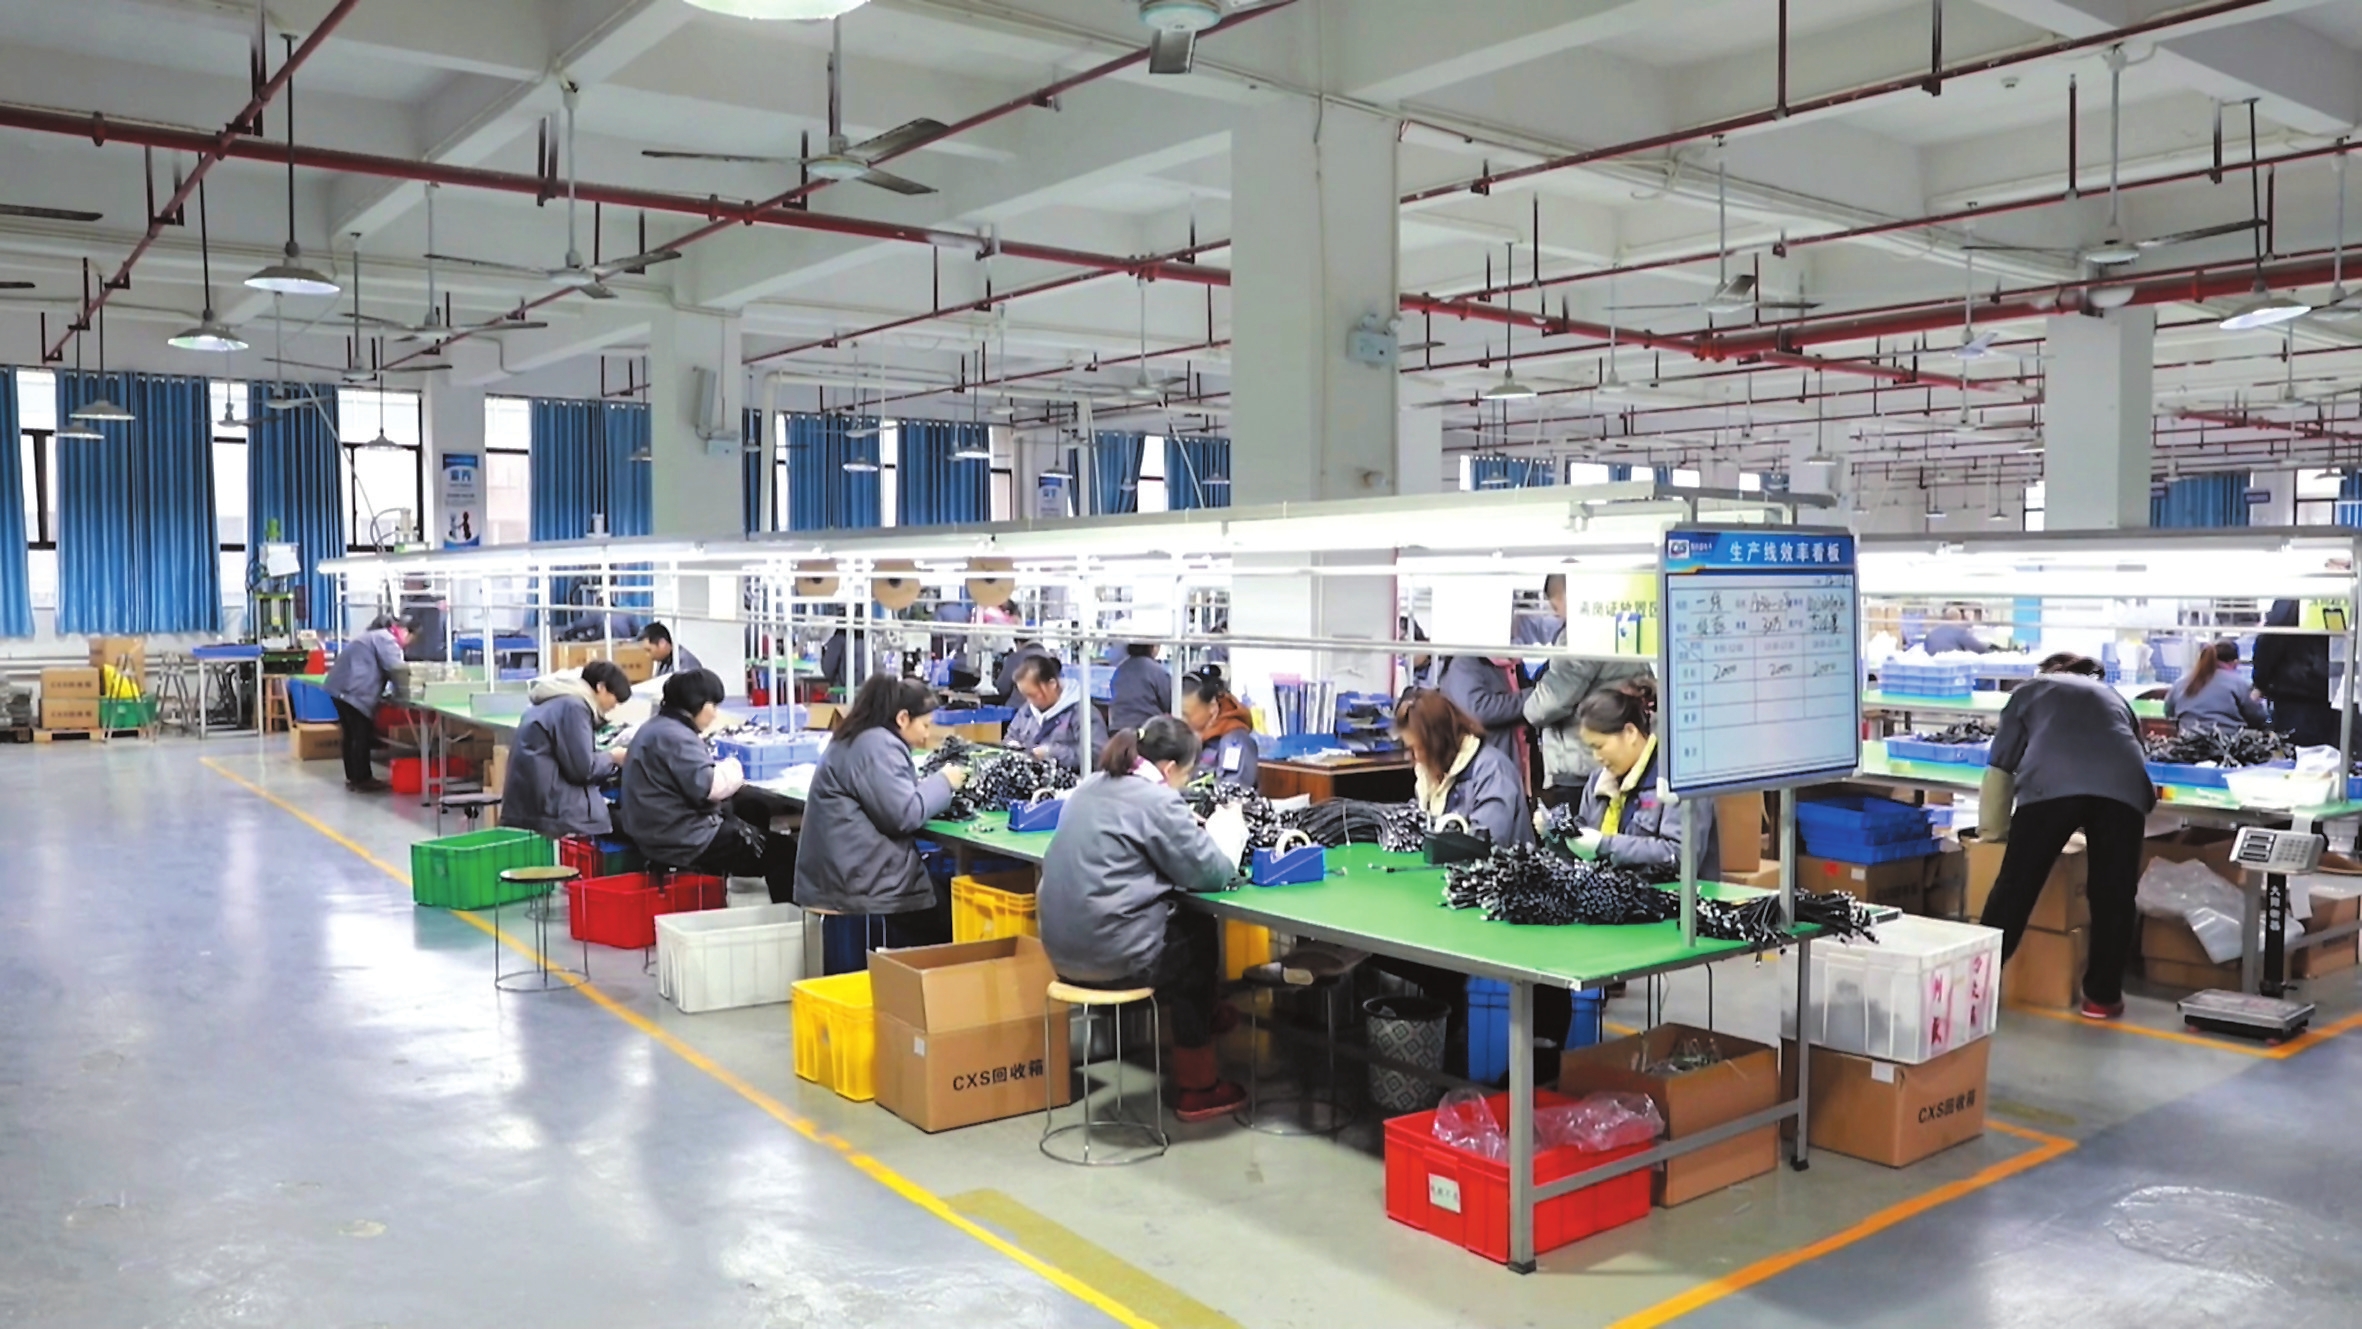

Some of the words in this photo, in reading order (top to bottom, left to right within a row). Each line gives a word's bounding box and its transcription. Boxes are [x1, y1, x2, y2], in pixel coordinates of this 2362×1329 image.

[1729, 541, 1840, 563] 生产线效率看板
[952, 1059, 1044, 1091] CXS回收箱
[1918, 1089, 1976, 1123] CXS回收箱
